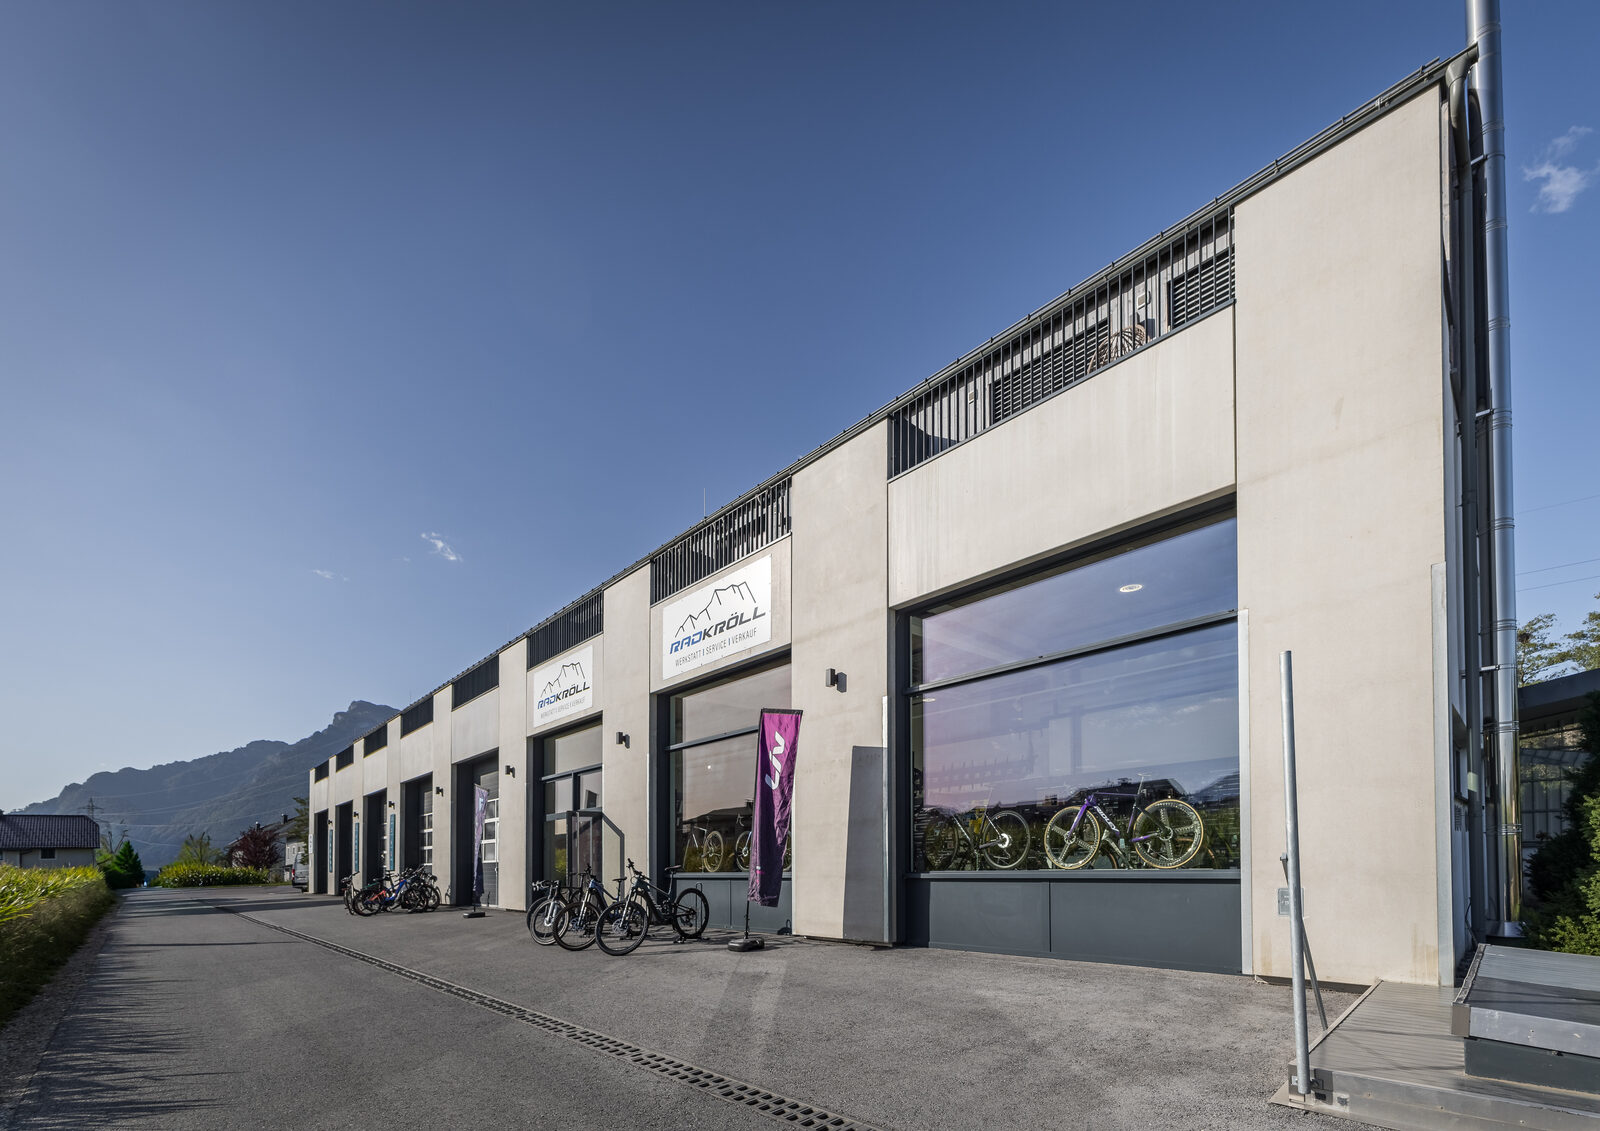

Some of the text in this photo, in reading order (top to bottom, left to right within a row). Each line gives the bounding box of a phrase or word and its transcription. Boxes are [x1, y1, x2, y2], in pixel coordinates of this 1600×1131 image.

[669, 606, 767, 655] RADKRÖLL
[675, 627, 757, 667] WERKSTATT SERVICE VERKAUF
[537, 681, 591, 710] RADKRÖLL
